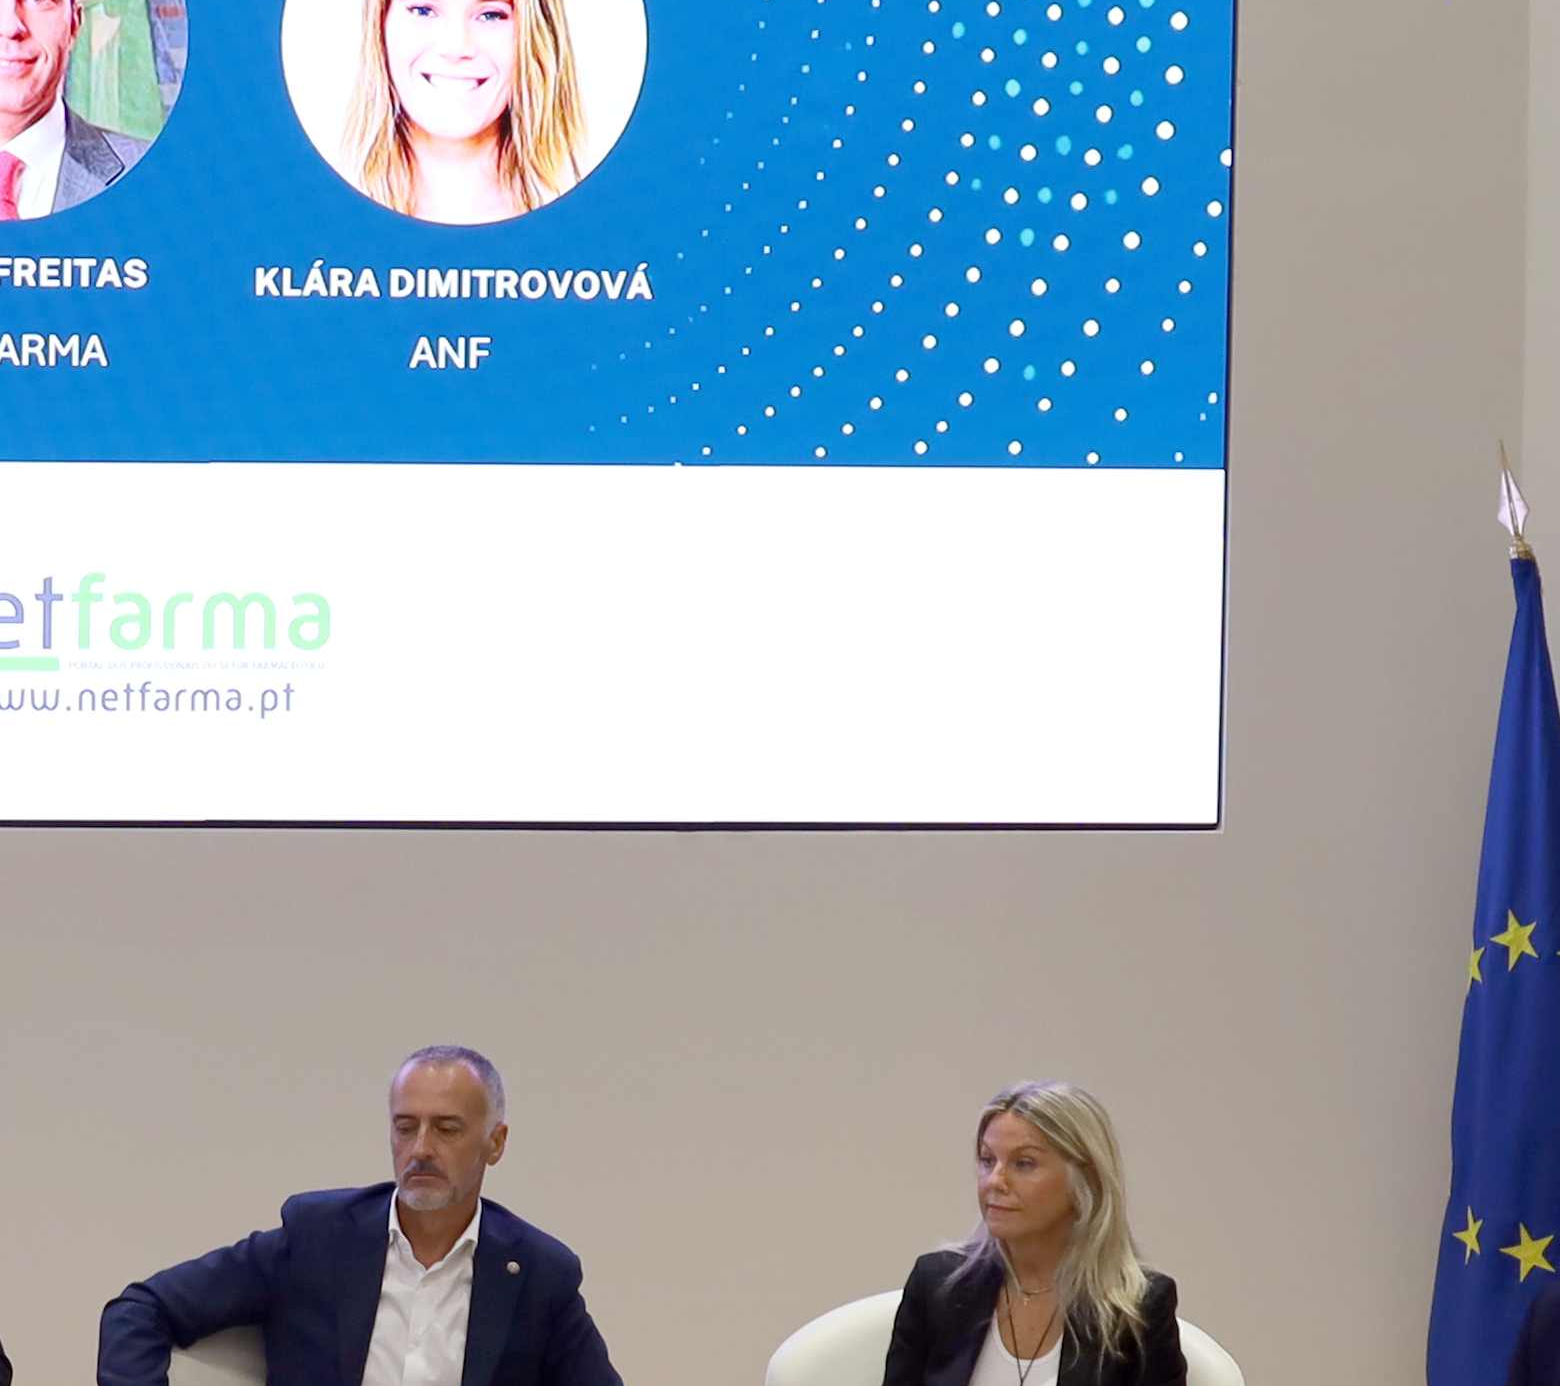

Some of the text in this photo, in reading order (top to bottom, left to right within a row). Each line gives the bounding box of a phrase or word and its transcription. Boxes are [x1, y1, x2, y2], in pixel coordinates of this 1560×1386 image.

[255, 260, 654, 300] KLÁRA DIMITROVOVÁ
[410, 336, 492, 369] ANF
